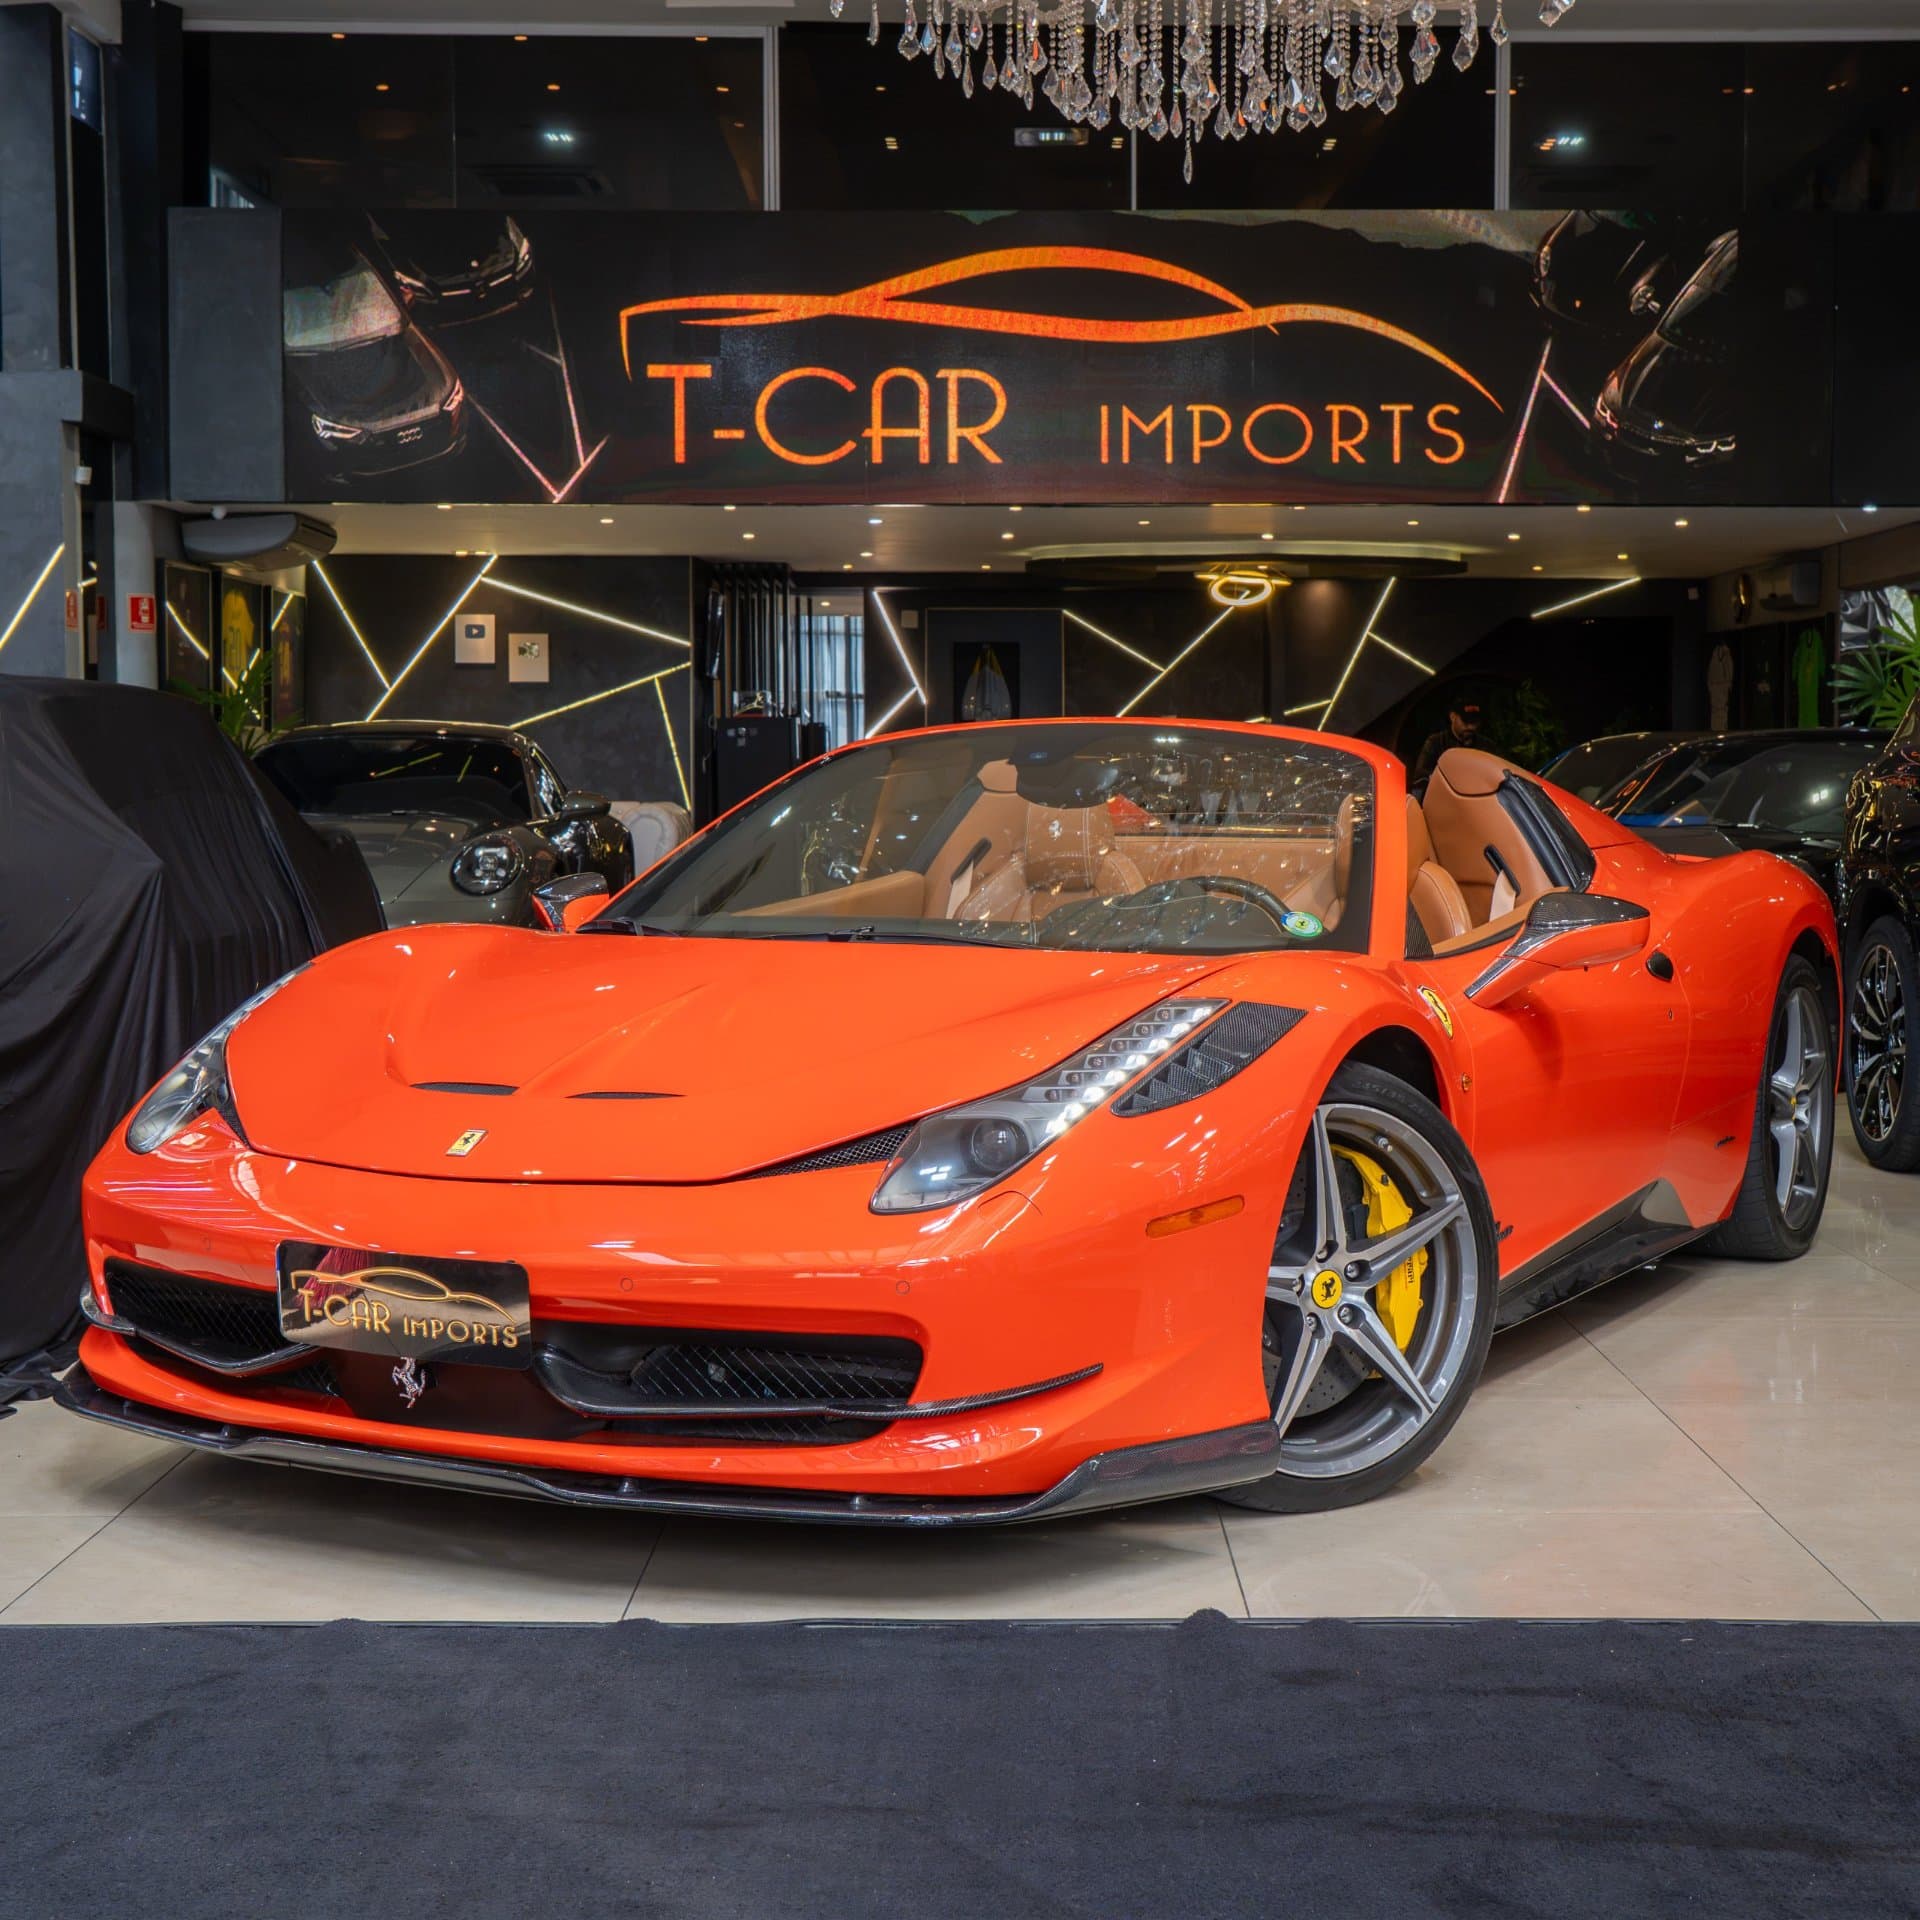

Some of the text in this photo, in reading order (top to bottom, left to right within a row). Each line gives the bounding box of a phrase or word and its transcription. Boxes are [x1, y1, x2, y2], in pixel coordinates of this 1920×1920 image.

[646, 363, 1465, 465] T-CAR IMPORTS
[297, 1288, 518, 1349] T-CAR IMPORTS
